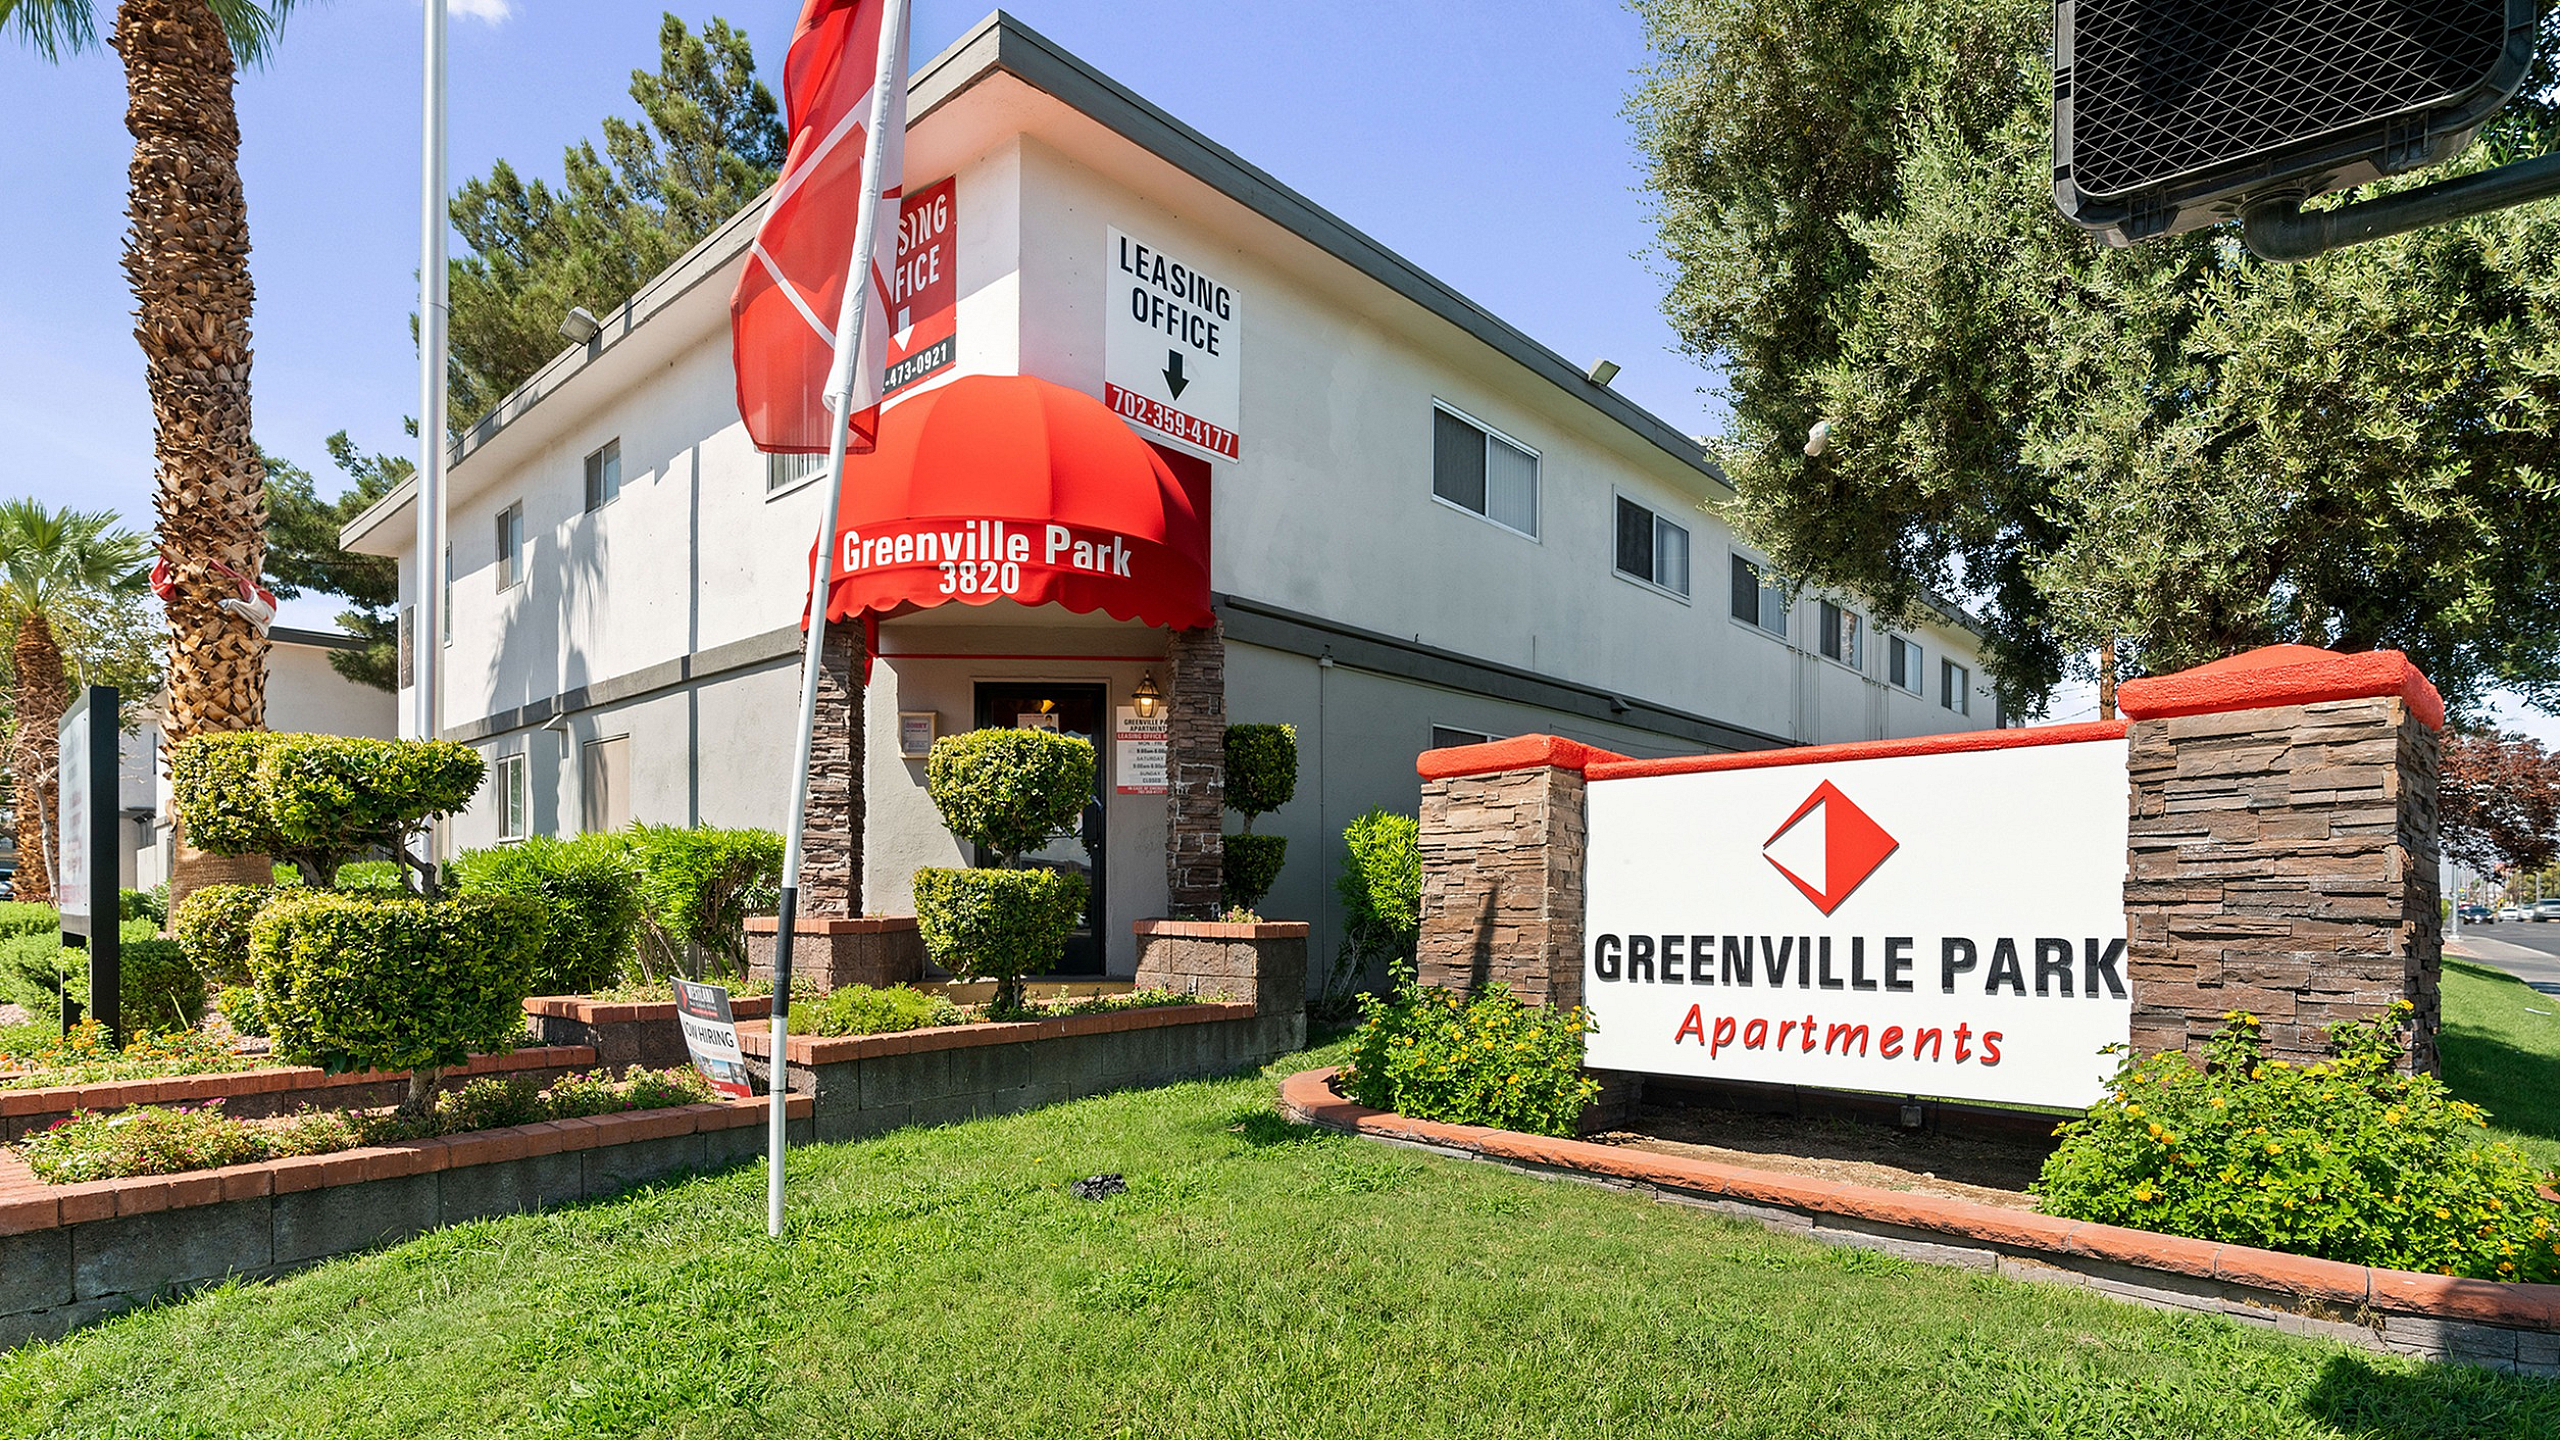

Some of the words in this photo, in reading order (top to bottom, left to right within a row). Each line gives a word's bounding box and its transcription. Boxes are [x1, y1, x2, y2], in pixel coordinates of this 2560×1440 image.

[897, 193, 947, 257] SING
[894, 244, 940, 304] FICE
[1119, 236, 1231, 321] LEASING
[1132, 286, 1220, 357] OFFICE
[882, 342, 947, 393] -473-0921
[1112, 386, 1233, 454] 702-359-4177
[842, 520, 1029, 573] Greenville
[1044, 523, 1132, 578] Park
[938, 561, 1020, 595] 3820
[1594, 933, 1914, 992] GREENVILLE
[1941, 936, 2128, 999] PARK
[698, 1026, 735, 1048] HIRING
[1674, 1003, 2004, 1067] Apartments
